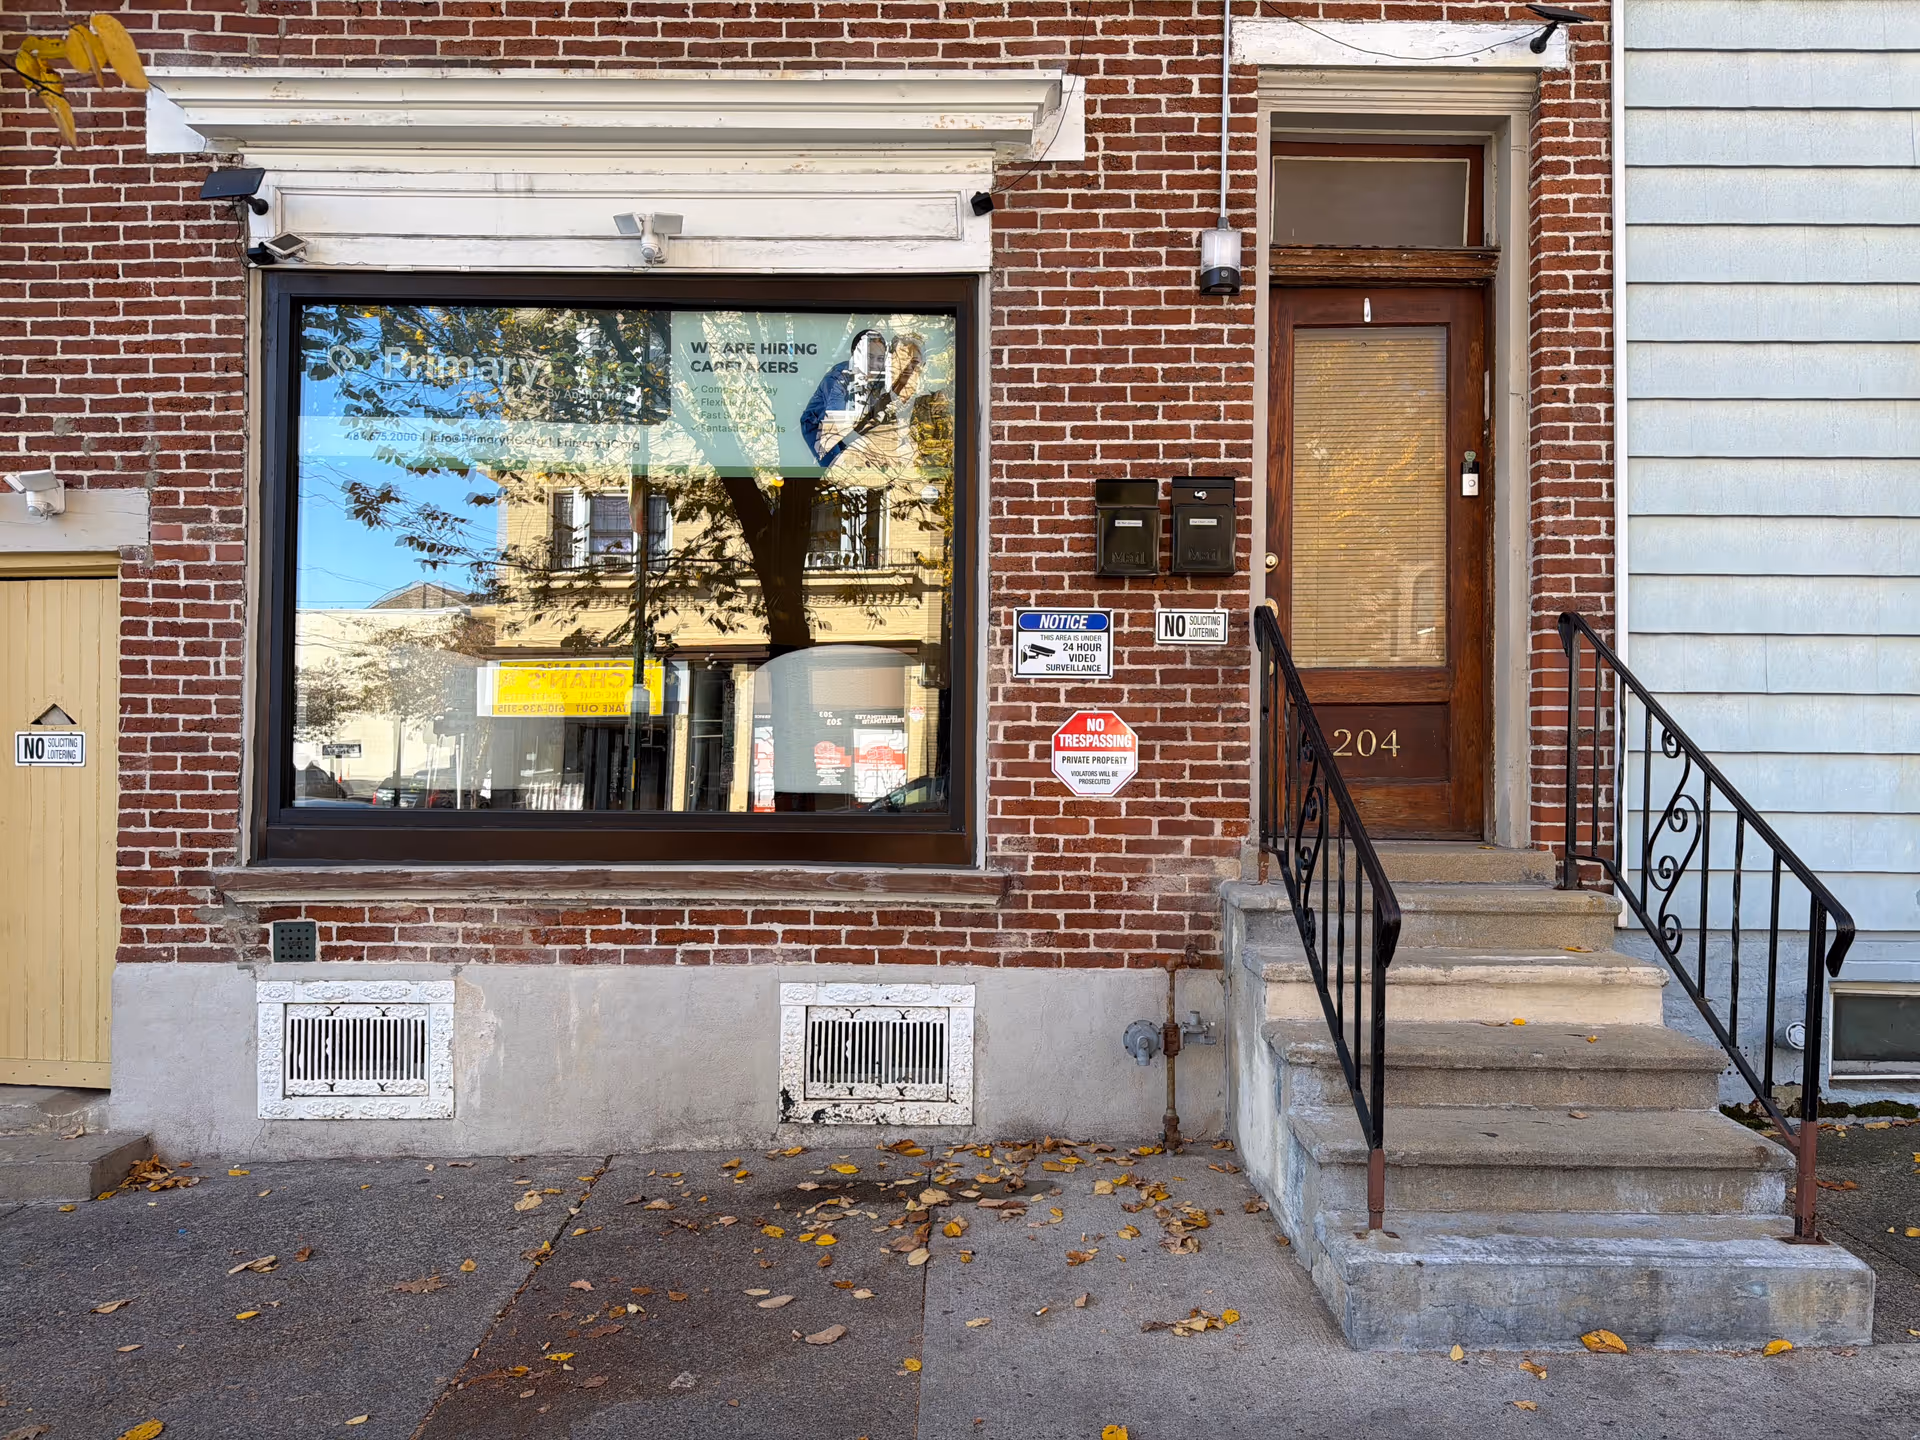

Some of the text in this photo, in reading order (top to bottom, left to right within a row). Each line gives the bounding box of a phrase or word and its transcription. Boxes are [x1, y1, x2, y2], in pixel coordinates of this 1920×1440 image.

[722, 342, 756, 355] ARE
[760, 342, 818, 356] HIRING
[384, 346, 540, 390] Primary
[546, 388, 560, 401] By
[563, 389, 603, 401] Anchor
[701, 411, 722, 420] Fast
[1038, 614, 1089, 629] NOTICE
[1164, 614, 1221, 638] NO SOLICITING
[1188, 627, 1219, 638] LOITERING
[1062, 642, 1102, 652] 24 HOUR
[1068, 653, 1096, 663] VIDEO
[1045, 663, 1102, 672] SURVEILLANCE
[1086, 718, 1105, 732] NO
[1058, 733, 1132, 748] TRESPASSING
[1332, 728, 1401, 758] 204
[23, 737, 78, 760] NO SOLICITING
[47, 749, 77, 760] LOITERING
[1061, 755, 1128, 765] PRIVATE PROPERTY
